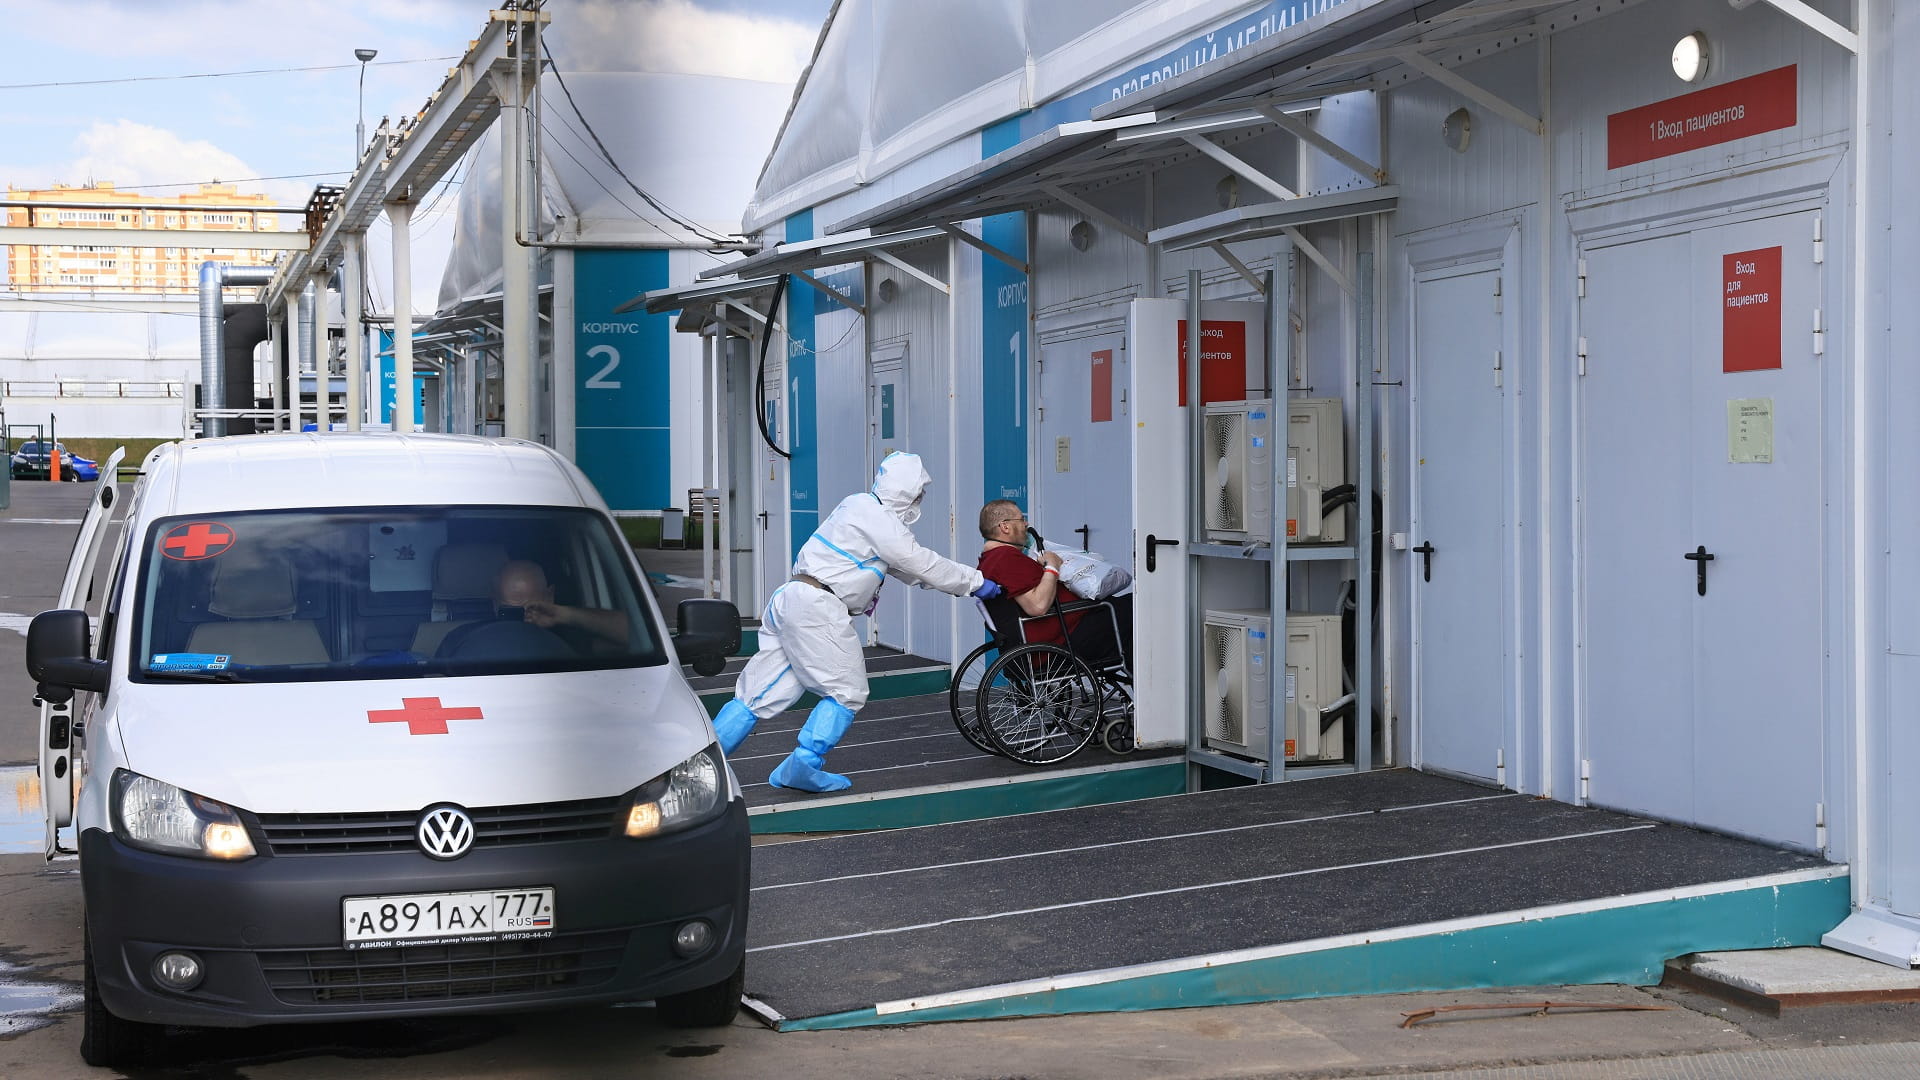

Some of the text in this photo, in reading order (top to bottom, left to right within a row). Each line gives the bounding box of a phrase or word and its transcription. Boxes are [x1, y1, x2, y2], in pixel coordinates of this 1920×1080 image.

[1650, 104, 1745, 142] 1 Вход пациентов
[1735, 260, 1756, 275] Вход
[997, 281, 1027, 309] КОРПУС
[1726, 280, 1741, 294] для
[1727, 292, 1769, 309] пациентов
[582, 322, 639, 334] КОРПУС
[1199, 329, 1224, 339] ыход
[585, 344, 621, 389] 2
[1009, 331, 1021, 427] 1
[791, 375, 800, 448] 1
[357, 893, 544, 935] А891АХ 777
[507, 917, 532, 927] RUS
[360, 940, 392, 949] АВИЛОН
[396, 938, 439, 947] Официальный
[461, 935, 497, 943] Volkswagen
[502, 931, 552, 941] (495)730-44-47
